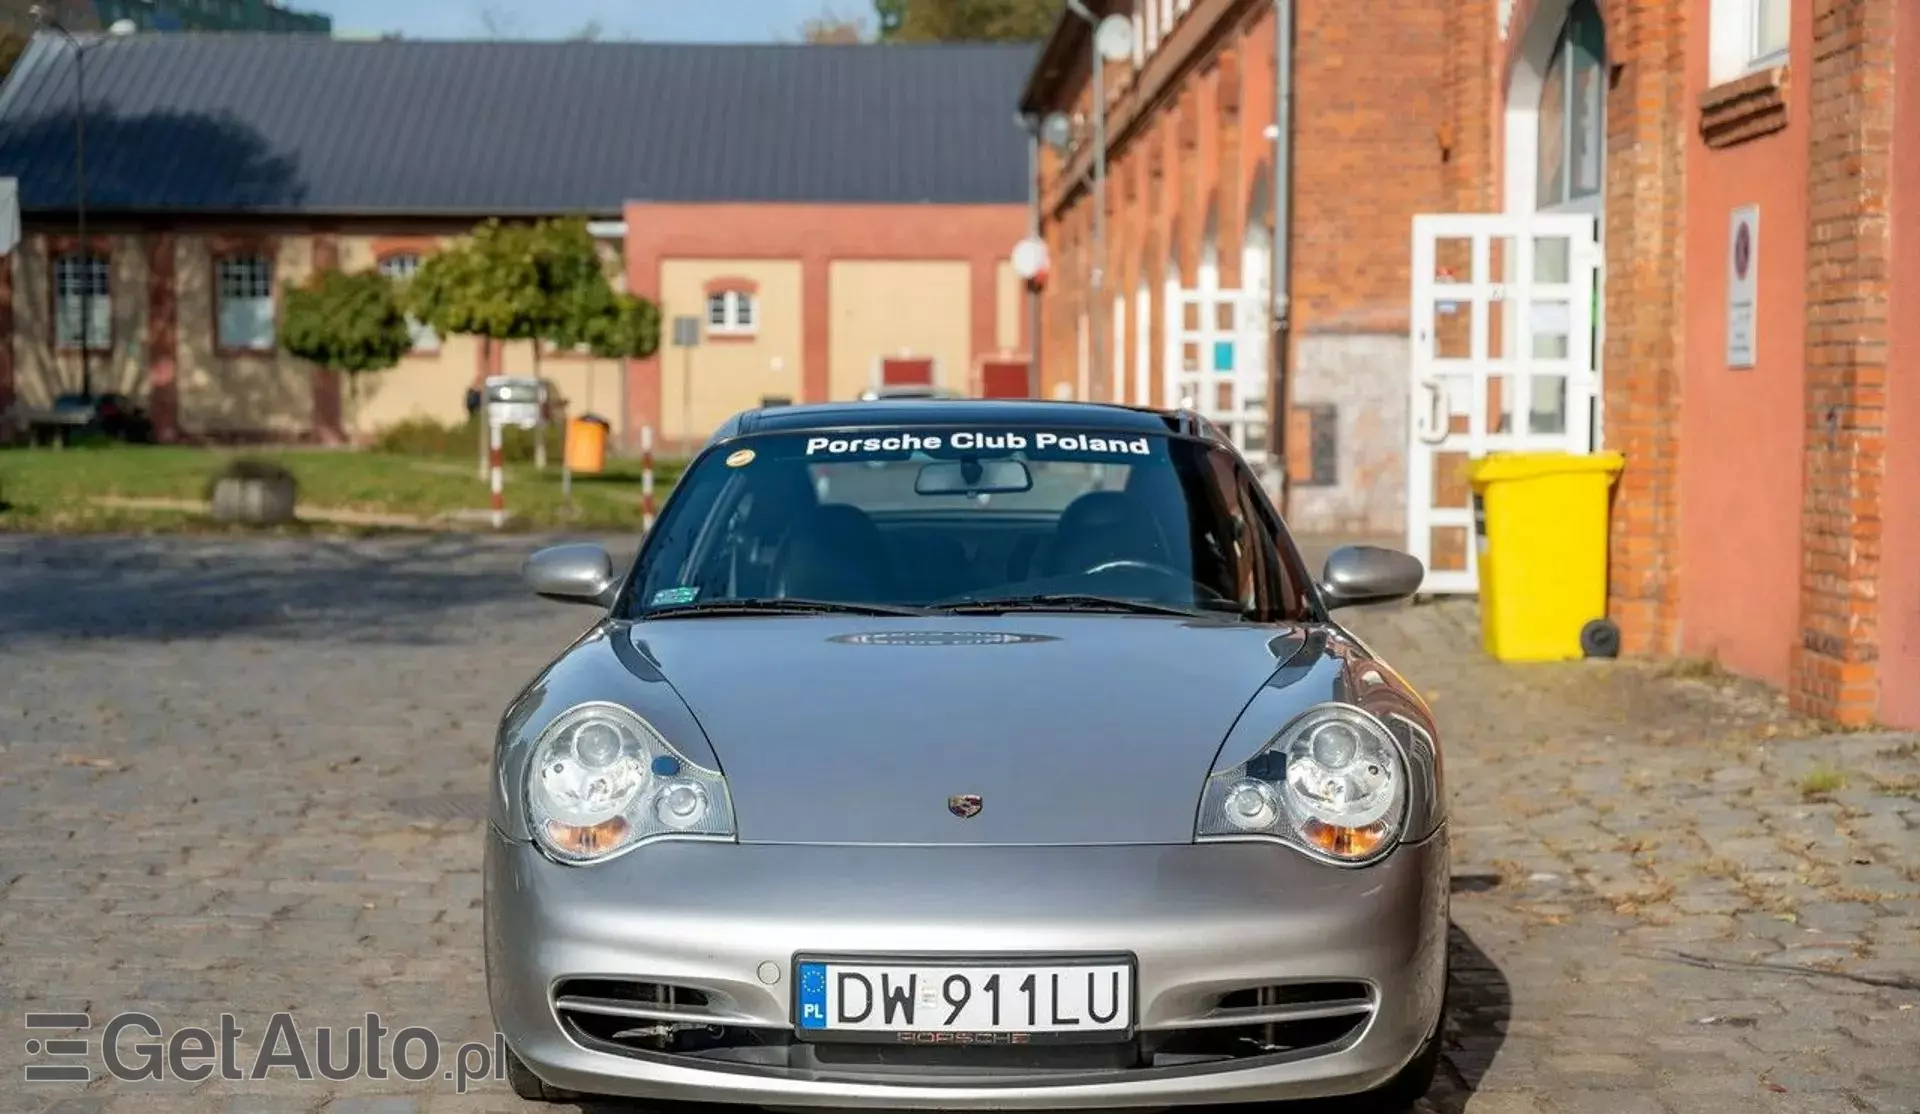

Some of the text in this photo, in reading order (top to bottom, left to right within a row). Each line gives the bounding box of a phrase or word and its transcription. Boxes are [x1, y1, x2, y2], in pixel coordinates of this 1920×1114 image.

[806, 432, 1151, 455] Porsche Club Poland
[837, 972, 917, 1025] DW
[942, 972, 1120, 1026] 911LU
[804, 1003, 824, 1019] PL
